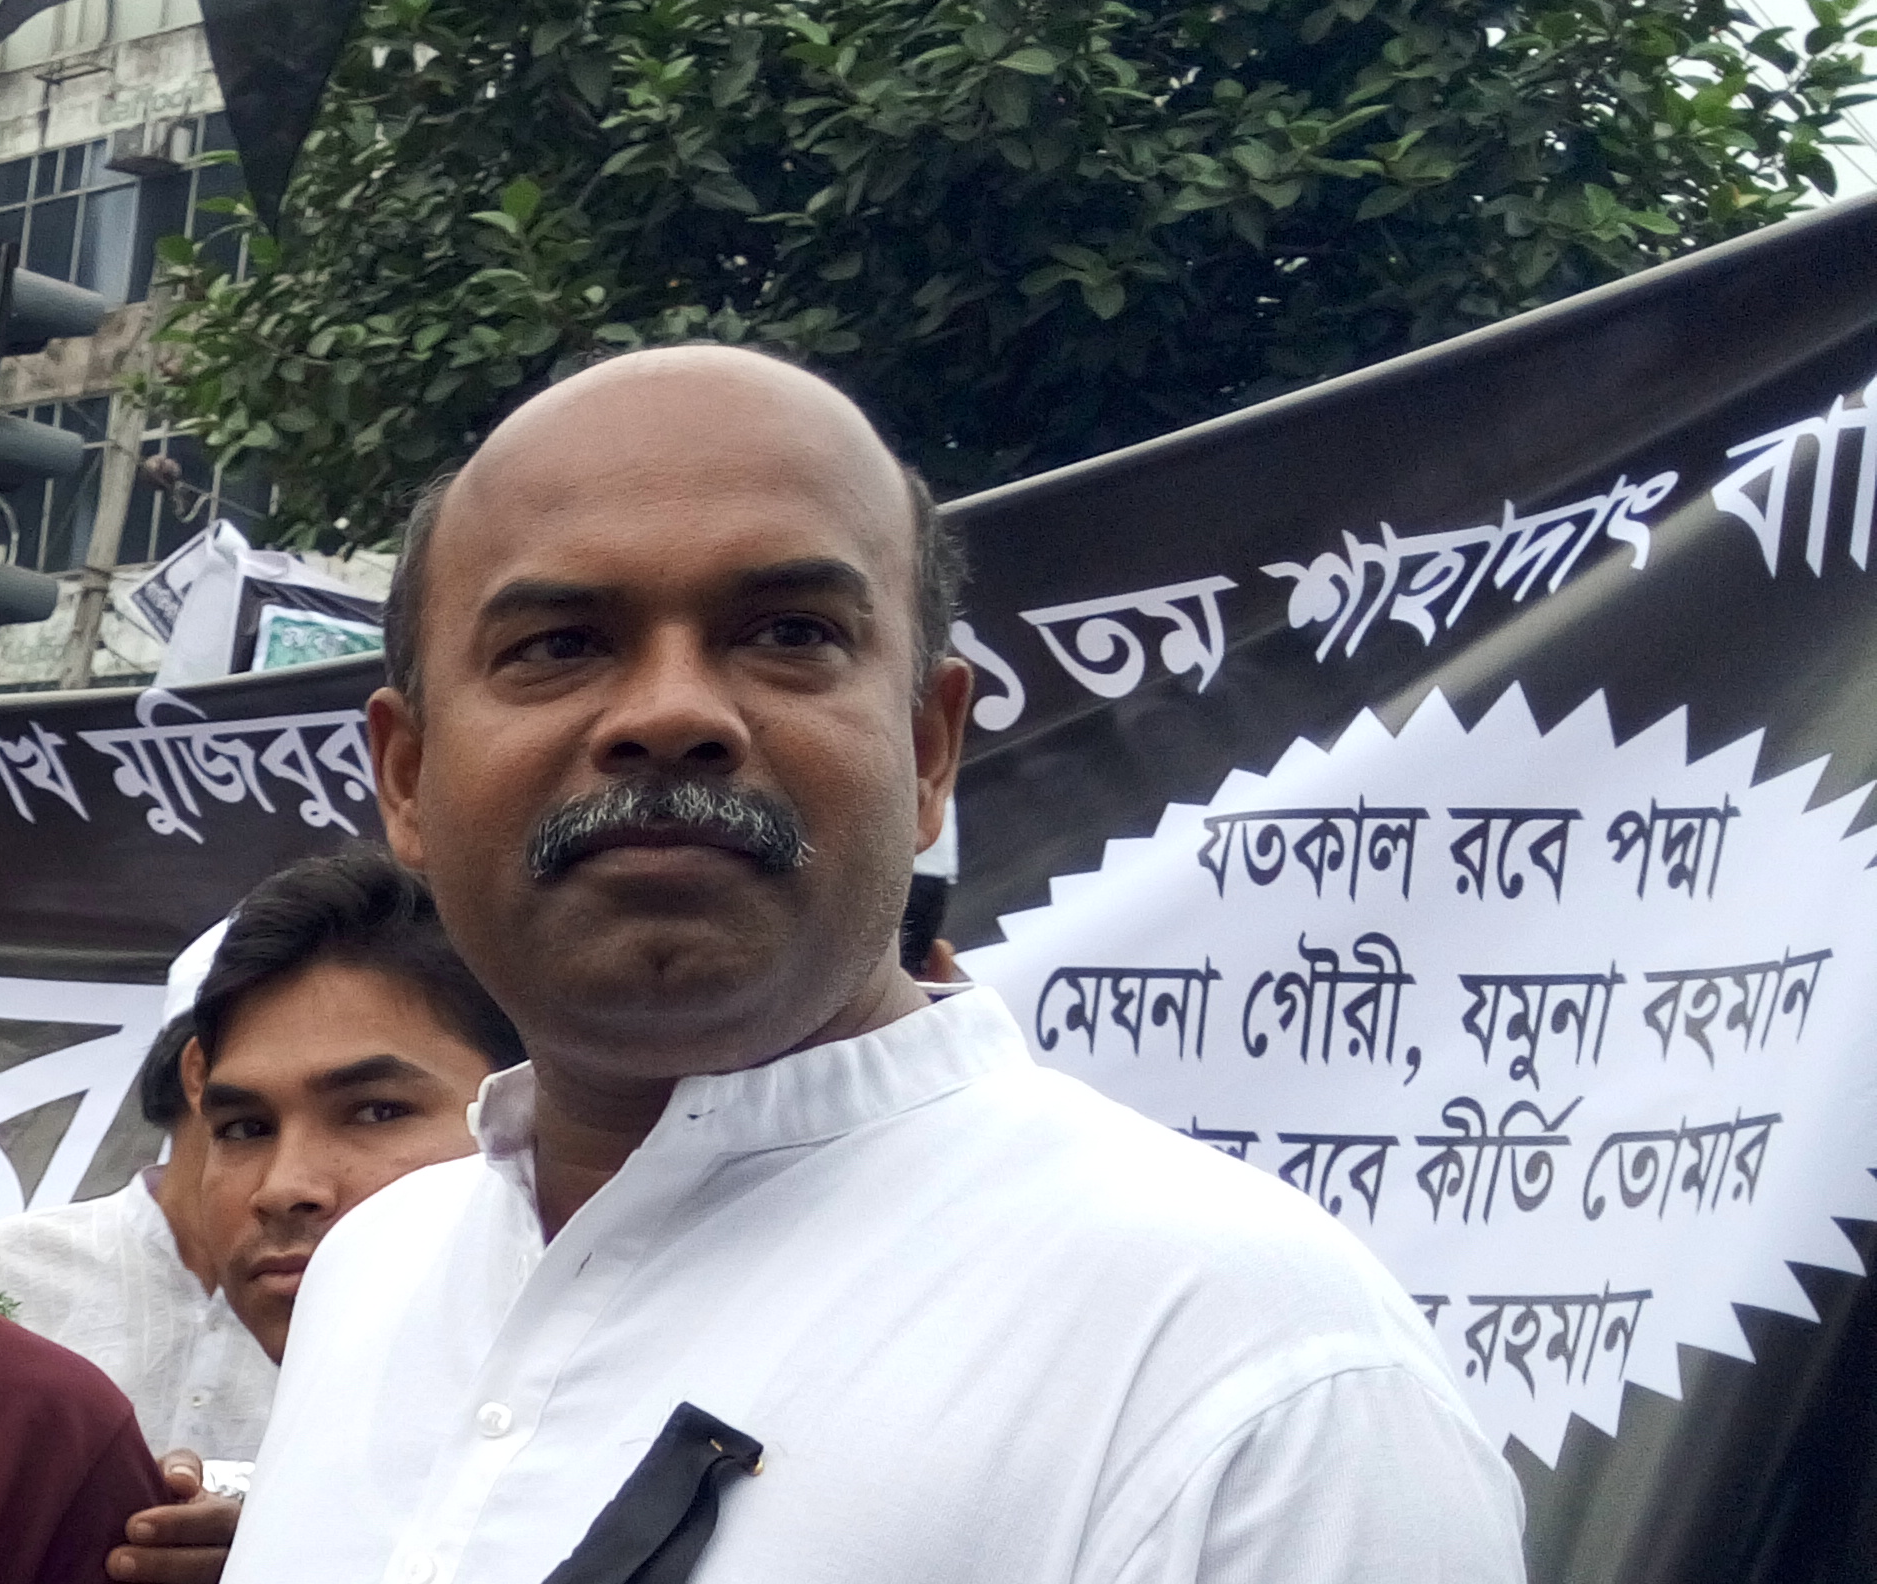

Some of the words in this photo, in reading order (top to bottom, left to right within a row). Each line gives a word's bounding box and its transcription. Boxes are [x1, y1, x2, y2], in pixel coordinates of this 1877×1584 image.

[77, 687, 379, 844] মুজিবুর
[1019, 575, 1237, 698] তম
[1260, 469, 1679, 664] শাহাদাৎ
[1198, 793, 1431, 903] যতকাল
[1447, 806, 1584, 903] রবে
[1606, 794, 1741, 899] পদ্মা
[1035, 955, 1223, 1062] মেঘনা
[1241, 930, 1423, 1086] গৌরী,
[1457, 960, 1626, 1091] যমুনা
[1413, 1095, 1584, 1226] কীর্তি
[1581, 1111, 1783, 1223] তোমার
[1464, 1280, 1654, 1389] রহমান
